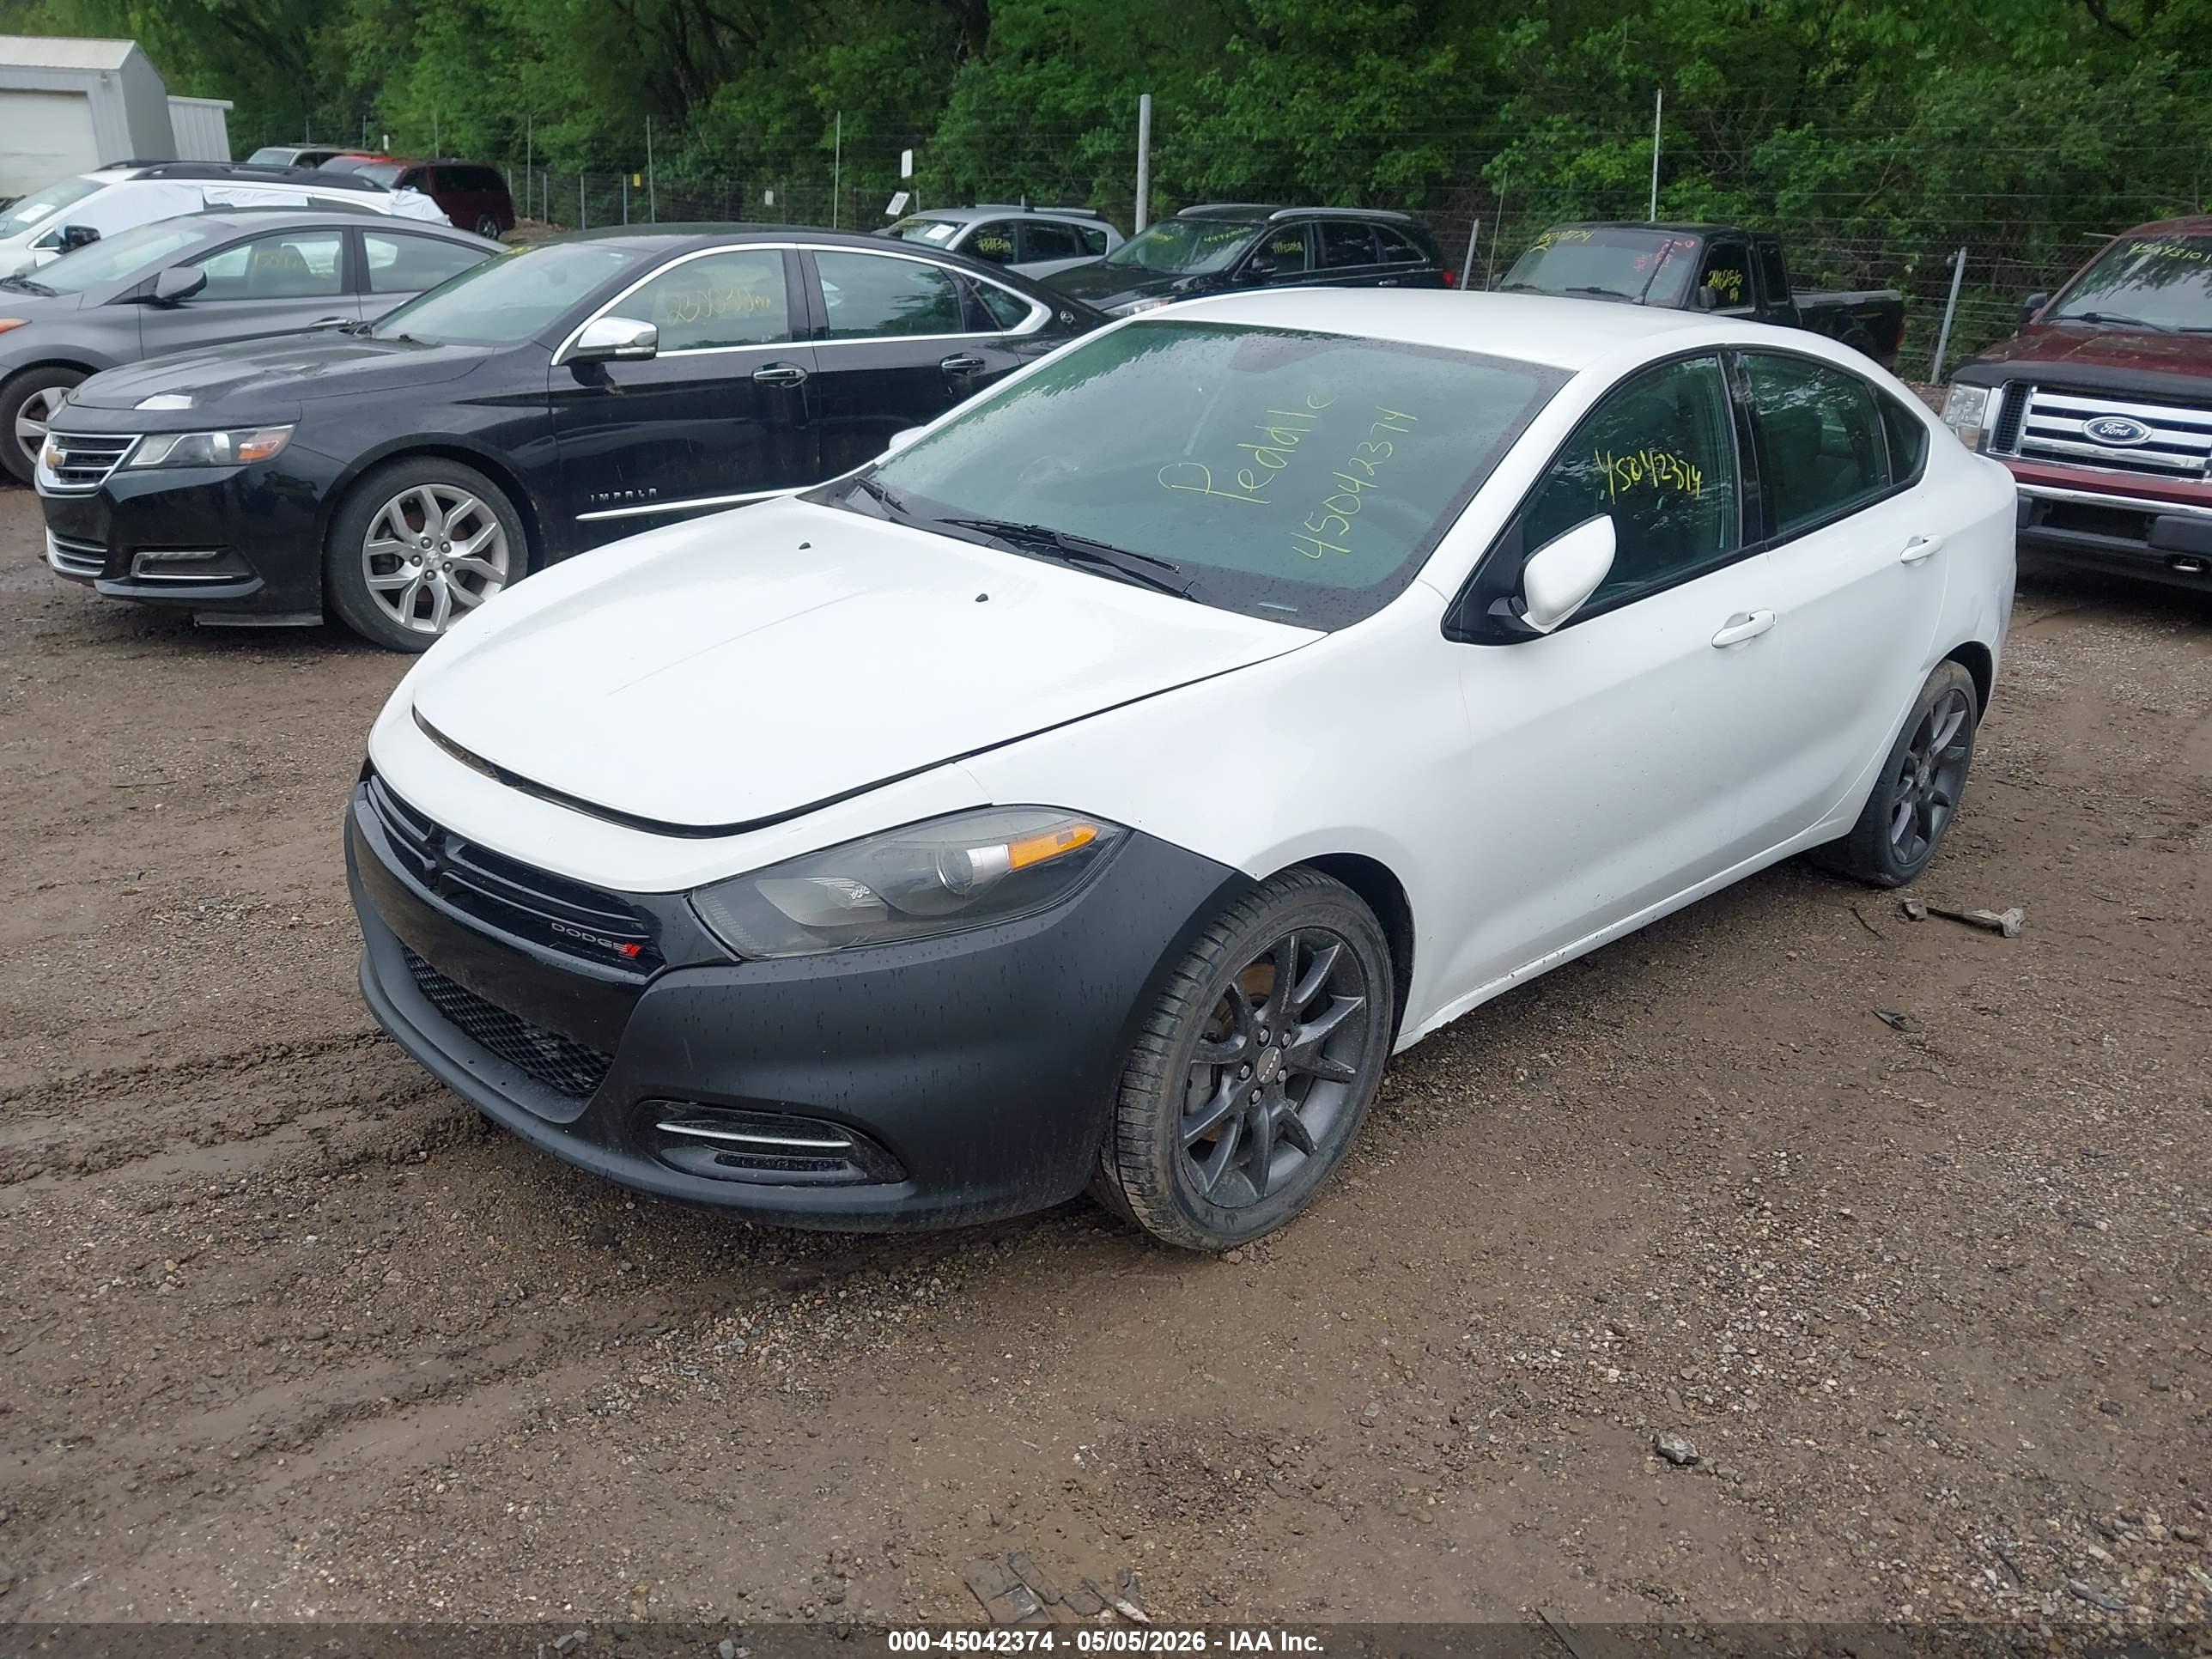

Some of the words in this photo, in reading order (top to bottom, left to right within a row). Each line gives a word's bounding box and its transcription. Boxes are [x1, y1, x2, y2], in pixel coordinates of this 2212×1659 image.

[2100, 422, 2132, 436] Ford
[1290, 404, 1419, 560] 45042374
[1595, 447, 1703, 506] 45042374
[590, 488, 658, 502] IMPALA
[551, 922, 629, 953] DODGE
